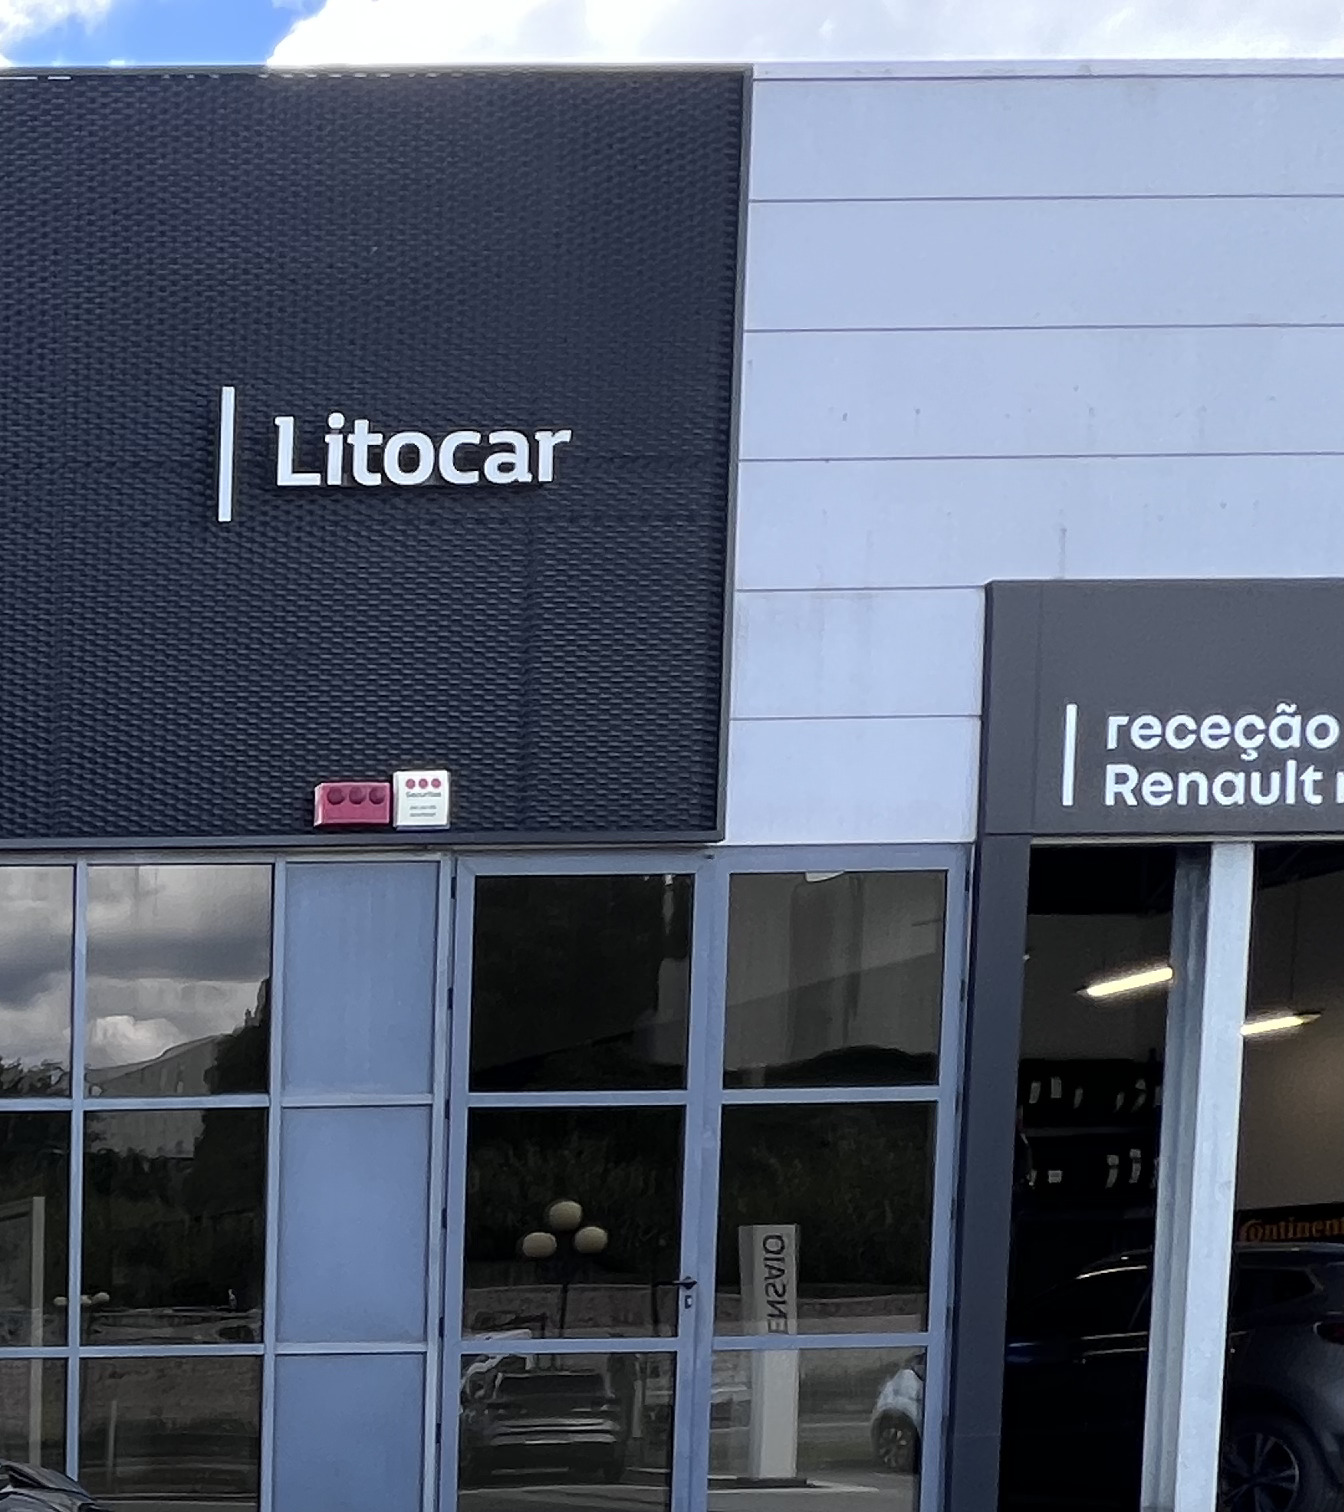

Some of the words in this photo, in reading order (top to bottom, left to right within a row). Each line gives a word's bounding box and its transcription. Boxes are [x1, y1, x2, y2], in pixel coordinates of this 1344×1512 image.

[274, 411, 573, 486] Litocar
[1106, 702, 1340, 762] receção
[1105, 759, 1323, 806] Renault
